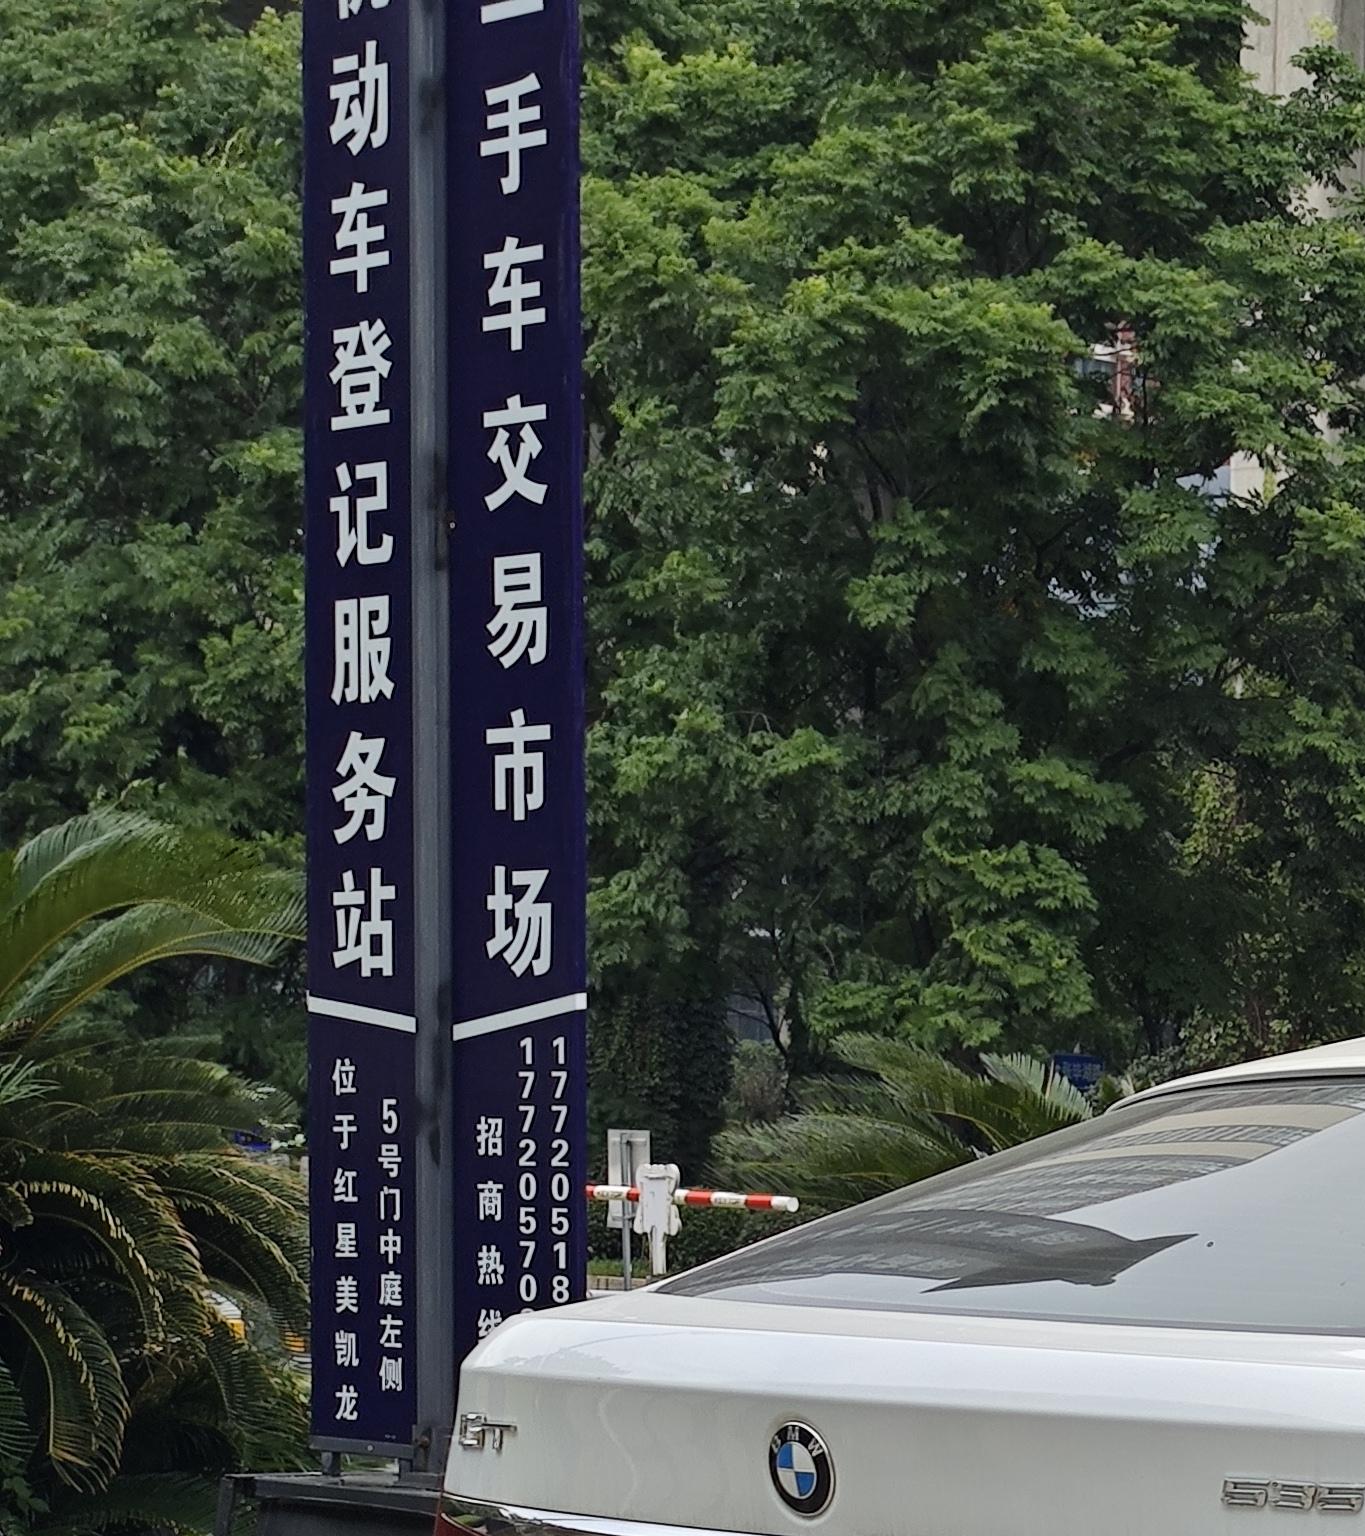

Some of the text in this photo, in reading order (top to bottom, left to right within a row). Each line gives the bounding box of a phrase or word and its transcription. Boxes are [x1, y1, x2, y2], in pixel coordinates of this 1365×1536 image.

[329, 0, 396, 977] 动车登记服务站
[331, 1058, 360, 1421] 位于红星美凯龙
[377, 1098, 404, 1392] 5号门中庭左侧
[518, 1037, 537, 1312] 17720570
[459, 1411, 517, 1450] GT
[771, 1425, 824, 1457] BMW
